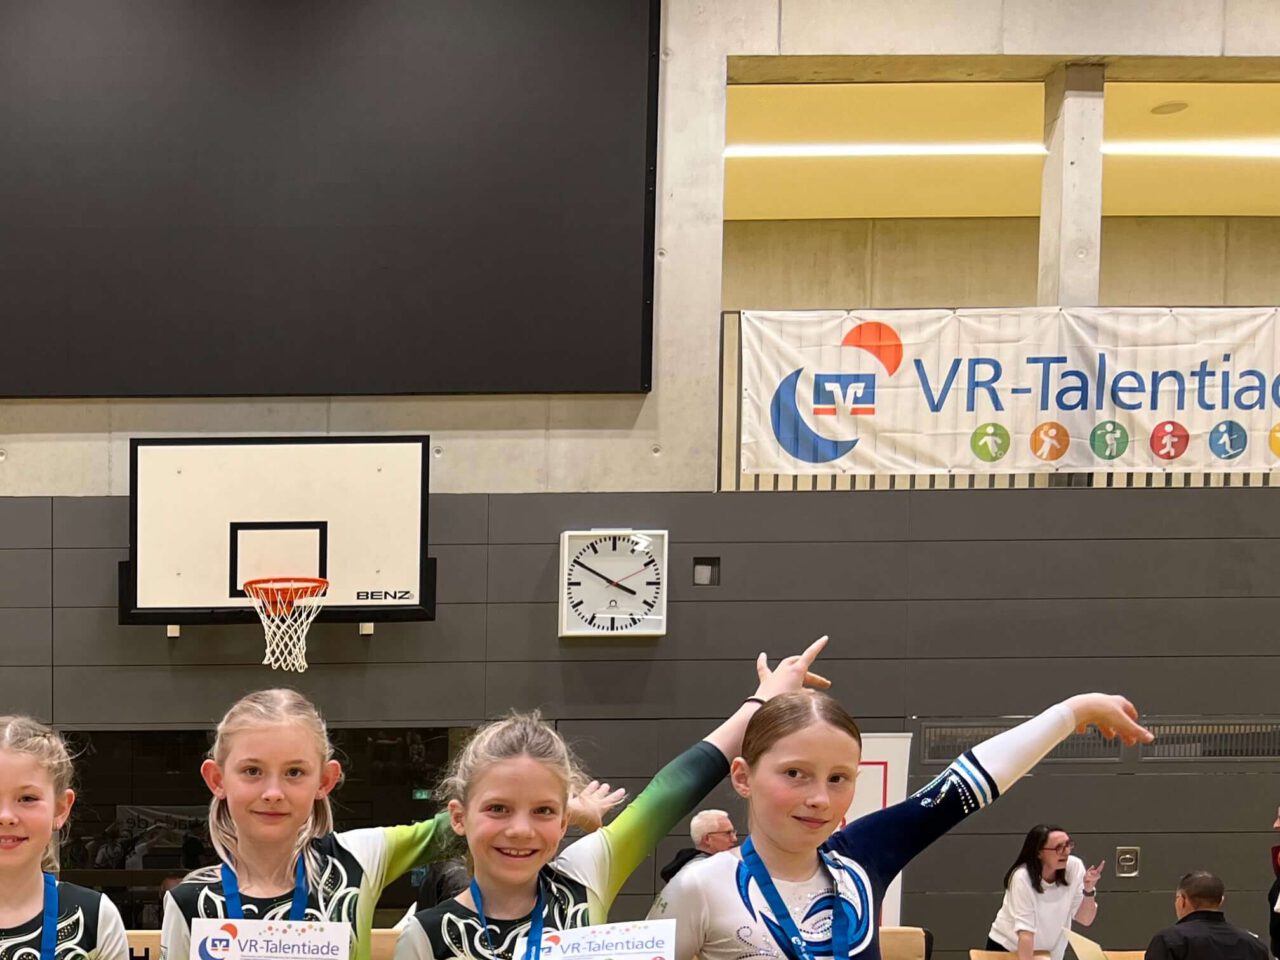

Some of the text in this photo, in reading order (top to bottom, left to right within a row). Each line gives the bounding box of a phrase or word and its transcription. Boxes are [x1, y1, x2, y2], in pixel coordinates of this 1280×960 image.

[913, 353, 1280, 412] VR-Talentia
[356, 591, 410, 600] BENZ
[238, 938, 340, 956] VR-Talentiade
[560, 937, 664, 954] VR-Talentiade
